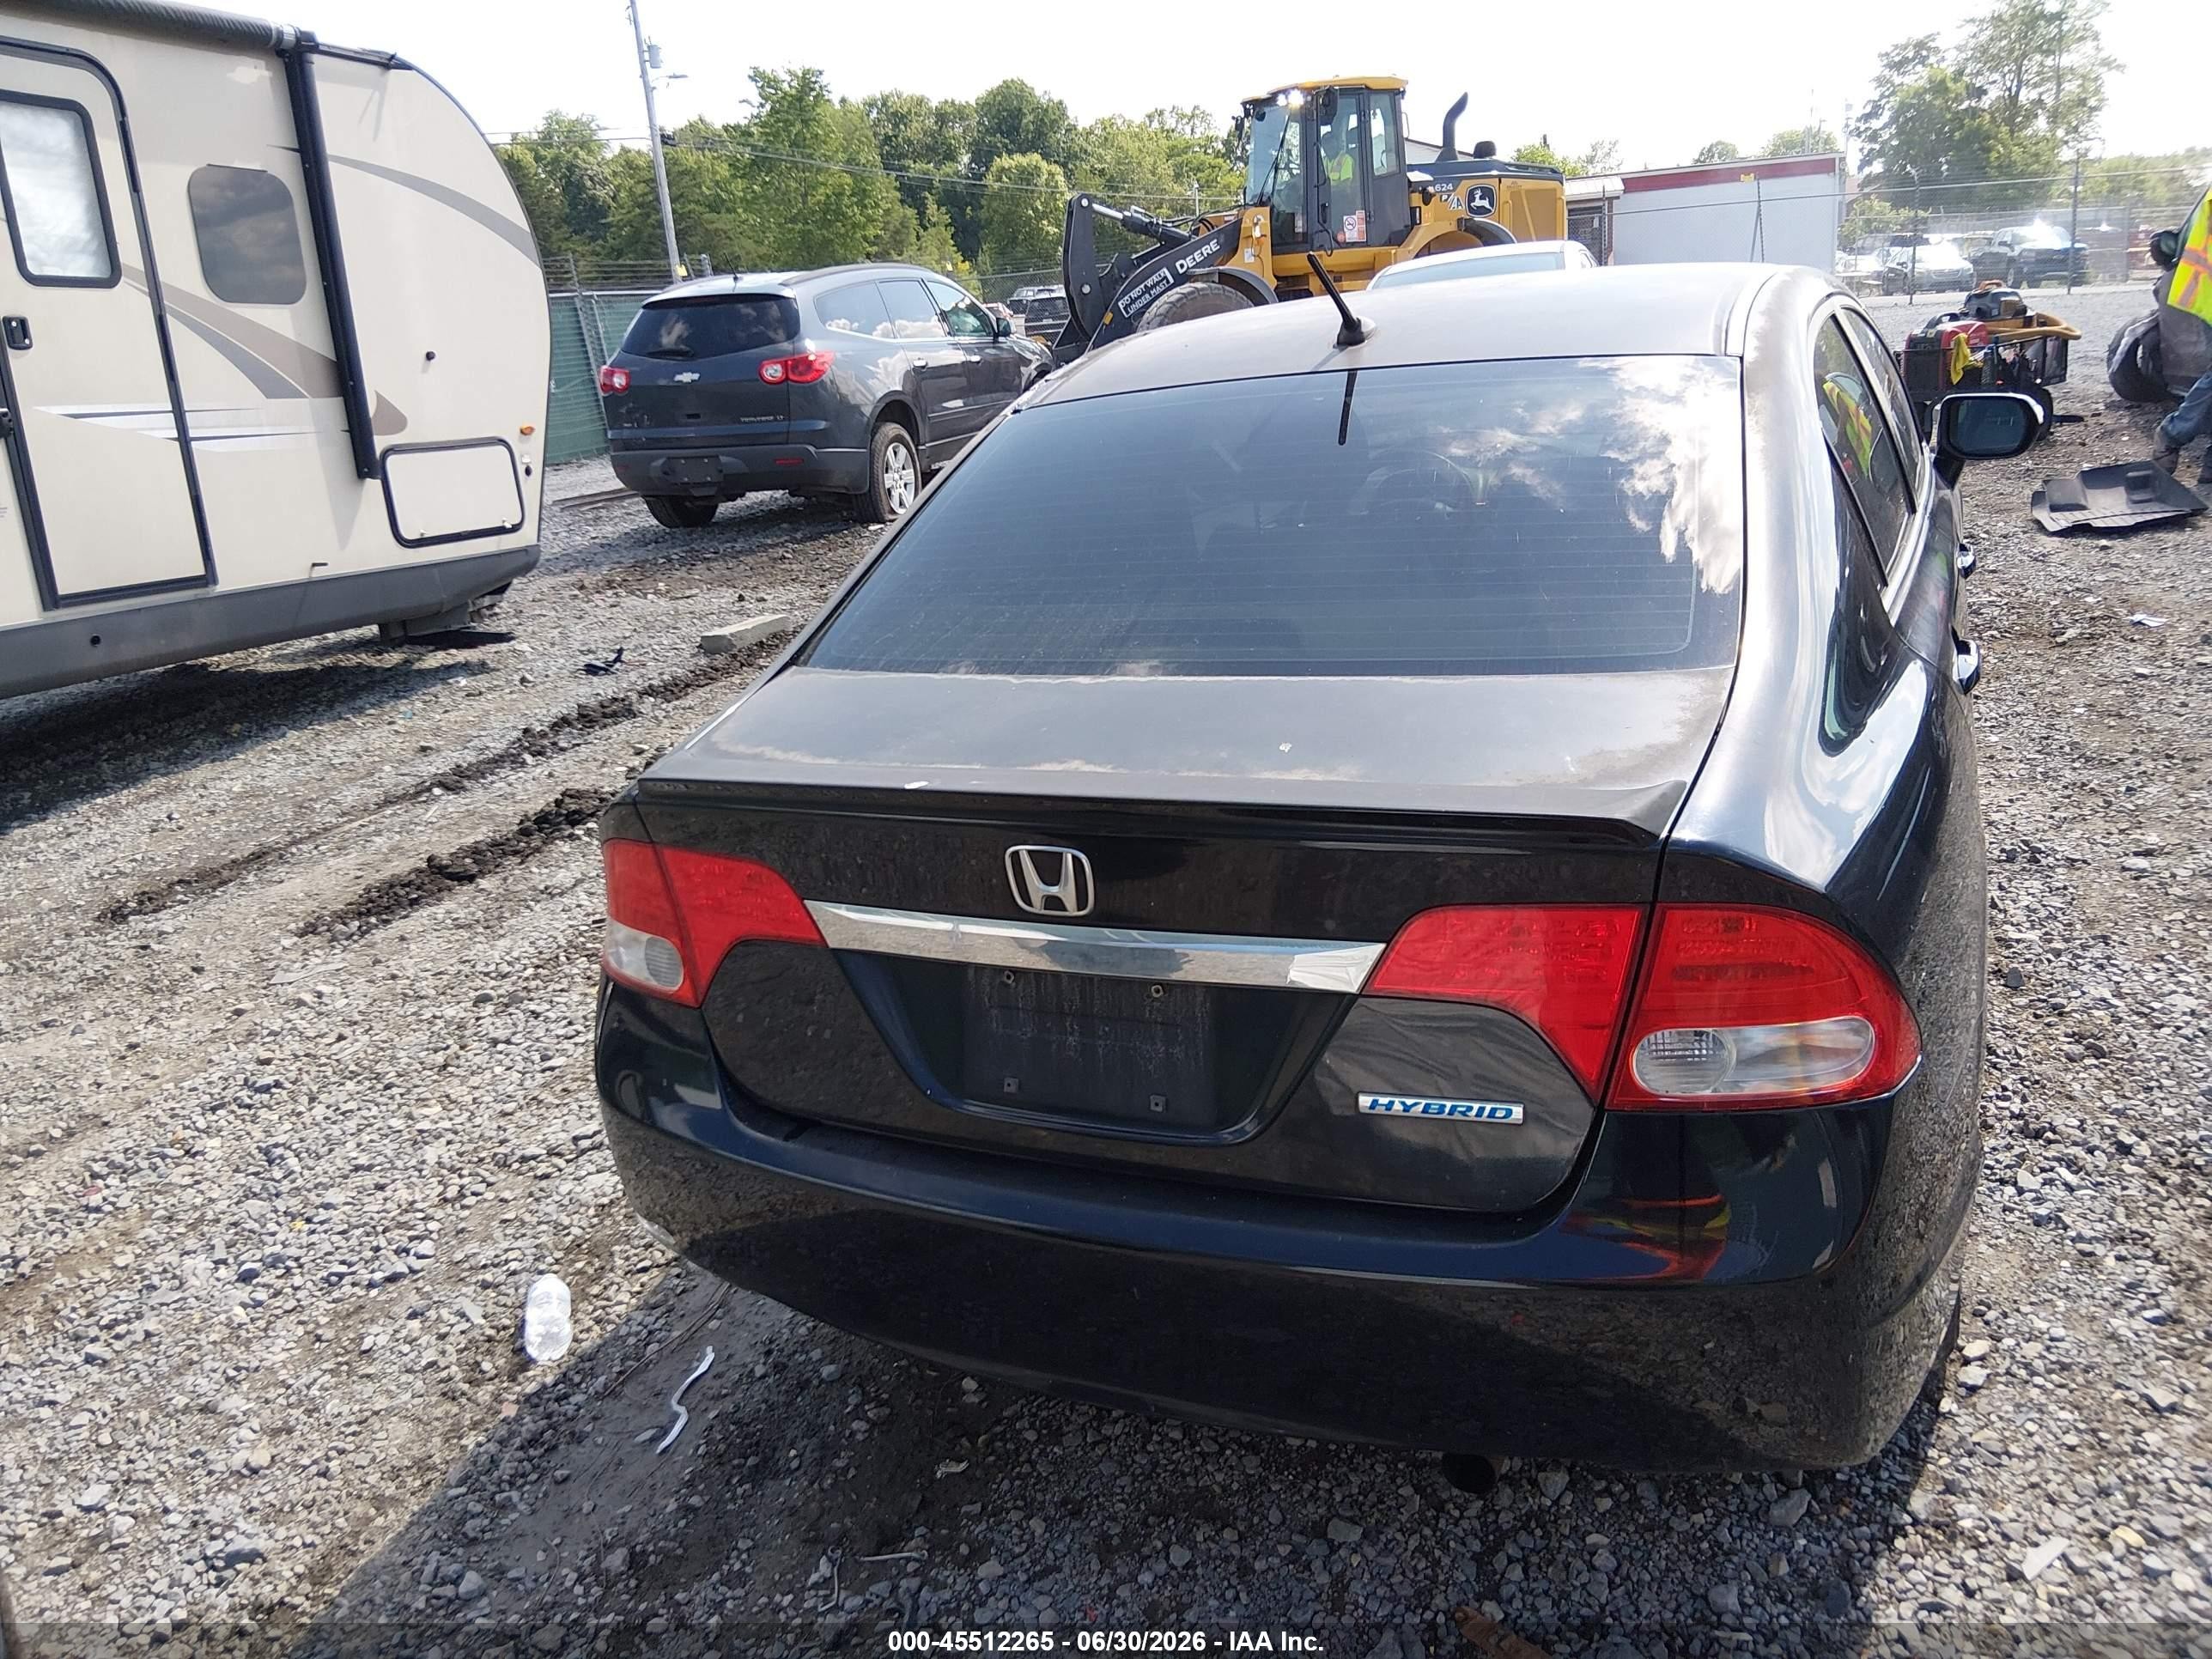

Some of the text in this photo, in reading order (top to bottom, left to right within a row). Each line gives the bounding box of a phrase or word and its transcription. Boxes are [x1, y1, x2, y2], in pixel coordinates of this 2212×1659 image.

[1434, 183, 1453, 191] 624
[1175, 239, 1220, 274] DEERE
[1120, 270, 1167, 308] DO NOT WALK
[1127, 279, 1169, 313] UNDER MAST
[1368, 1098, 1514, 1120] HYBRID
